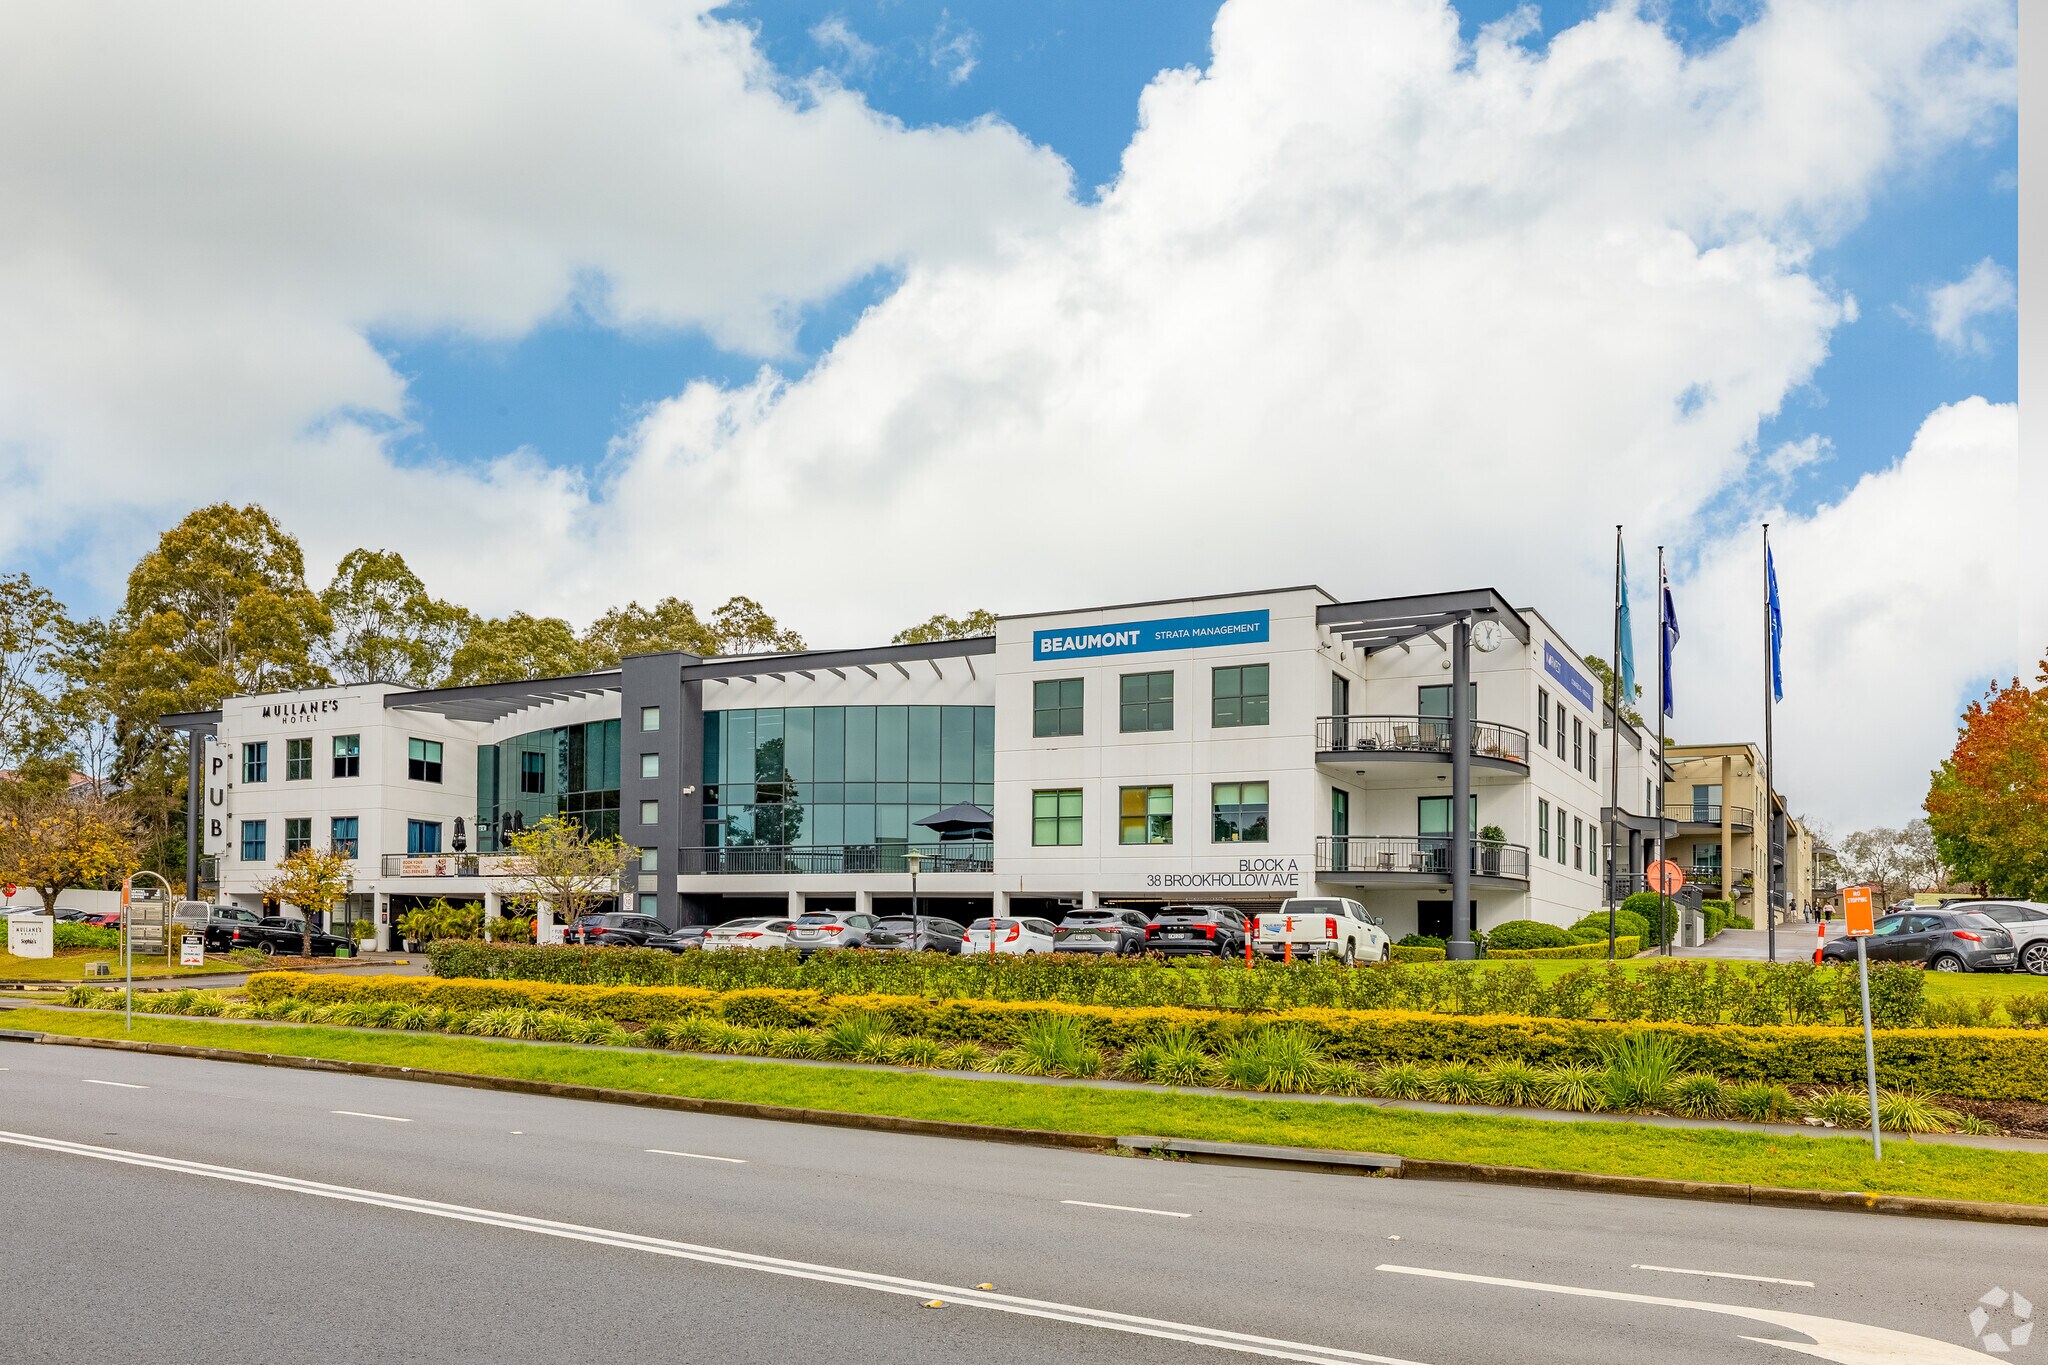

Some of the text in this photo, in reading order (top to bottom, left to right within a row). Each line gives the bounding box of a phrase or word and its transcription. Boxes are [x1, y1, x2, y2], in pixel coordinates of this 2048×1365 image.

[1041, 622, 1261, 653] BEAUMONT STRATA MANAGEMENT
[262, 700, 339, 718] MULLANE'S
[282, 714, 318, 725] HOTEL
[209, 757, 224, 837] PUB
[1239, 858, 1299, 872] BLOCK A
[1147, 873, 1299, 887] 38 BROOKHOLLOW AVE
